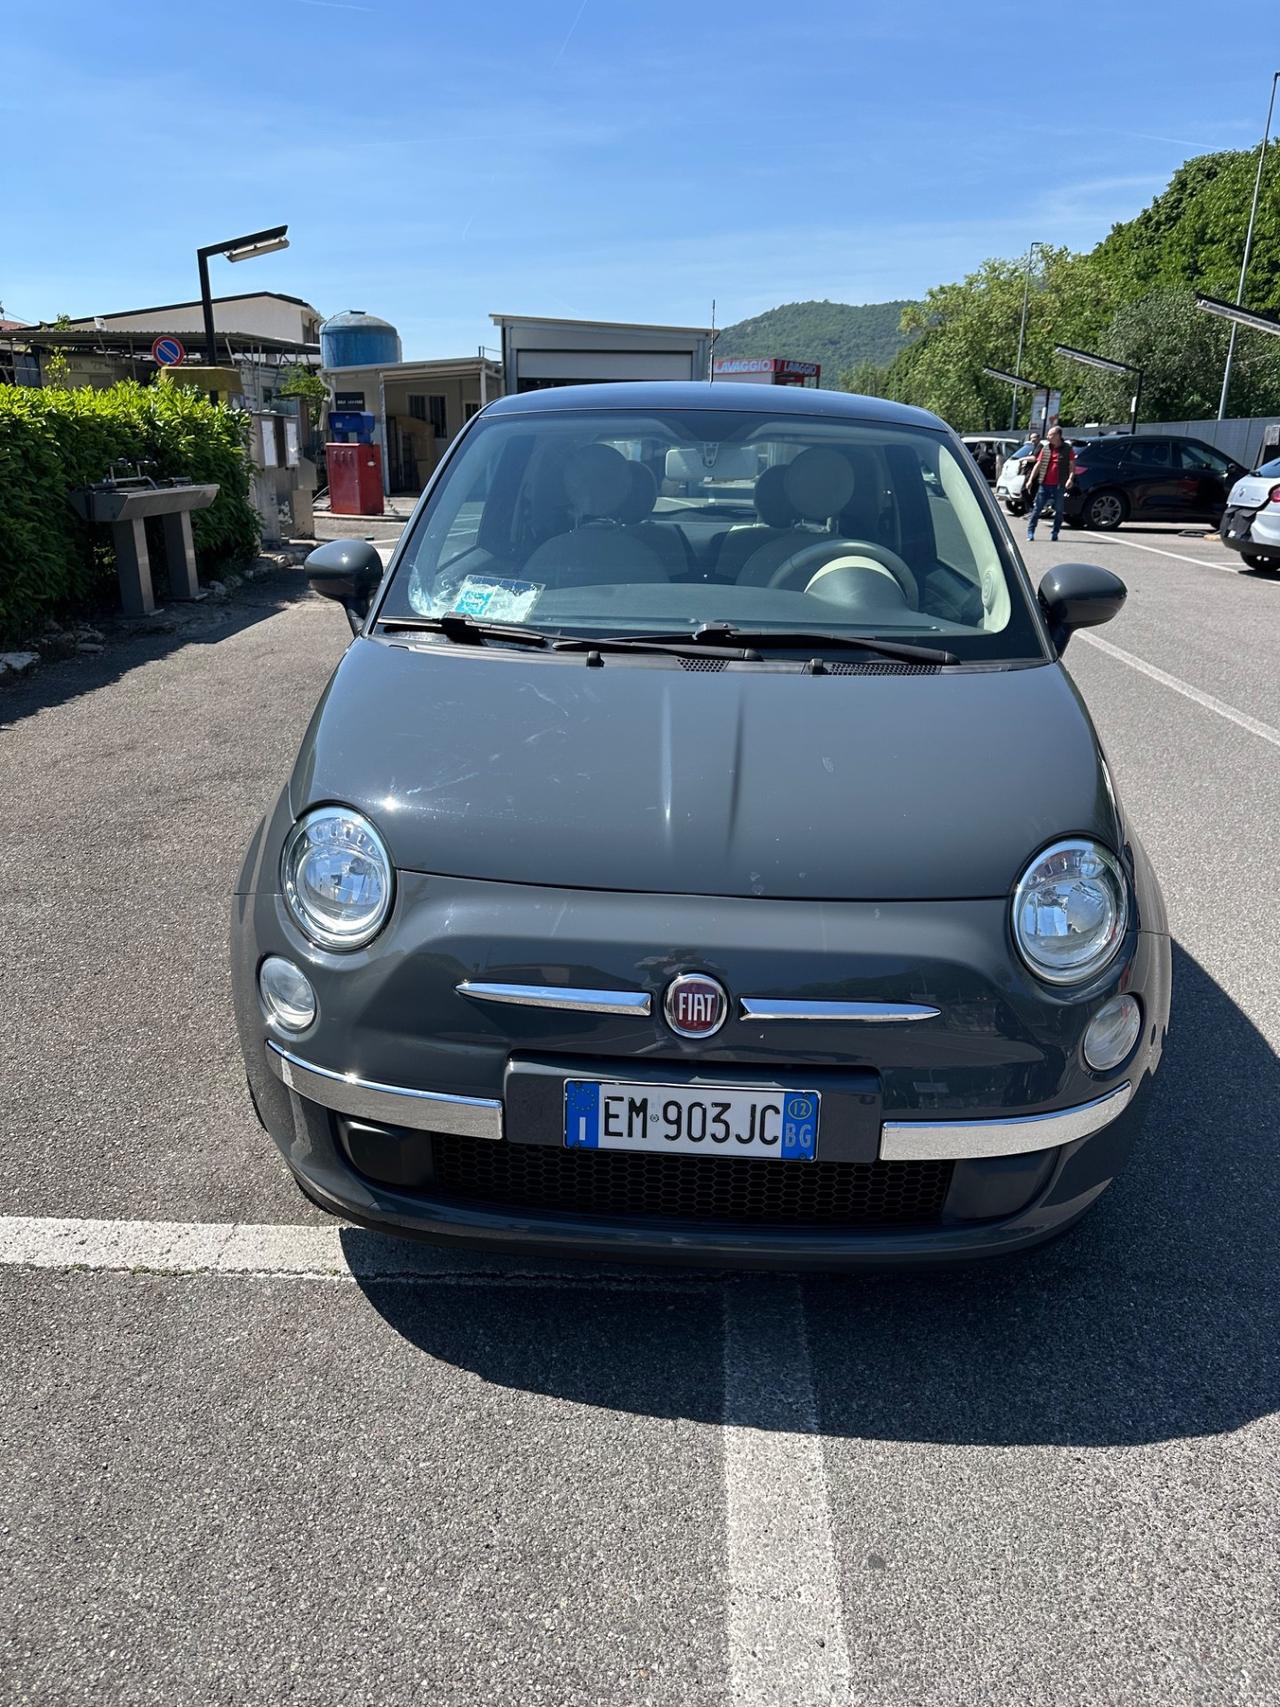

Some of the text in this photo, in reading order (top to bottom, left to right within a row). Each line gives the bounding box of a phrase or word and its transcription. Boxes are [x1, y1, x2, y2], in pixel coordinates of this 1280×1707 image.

[715, 359, 771, 374] LAVAGGIO
[783, 361, 817, 374] LAVAGGIO
[678, 992, 715, 1022] FIAT
[793, 1103, 807, 1115] 12
[785, 1123, 812, 1148] BG
